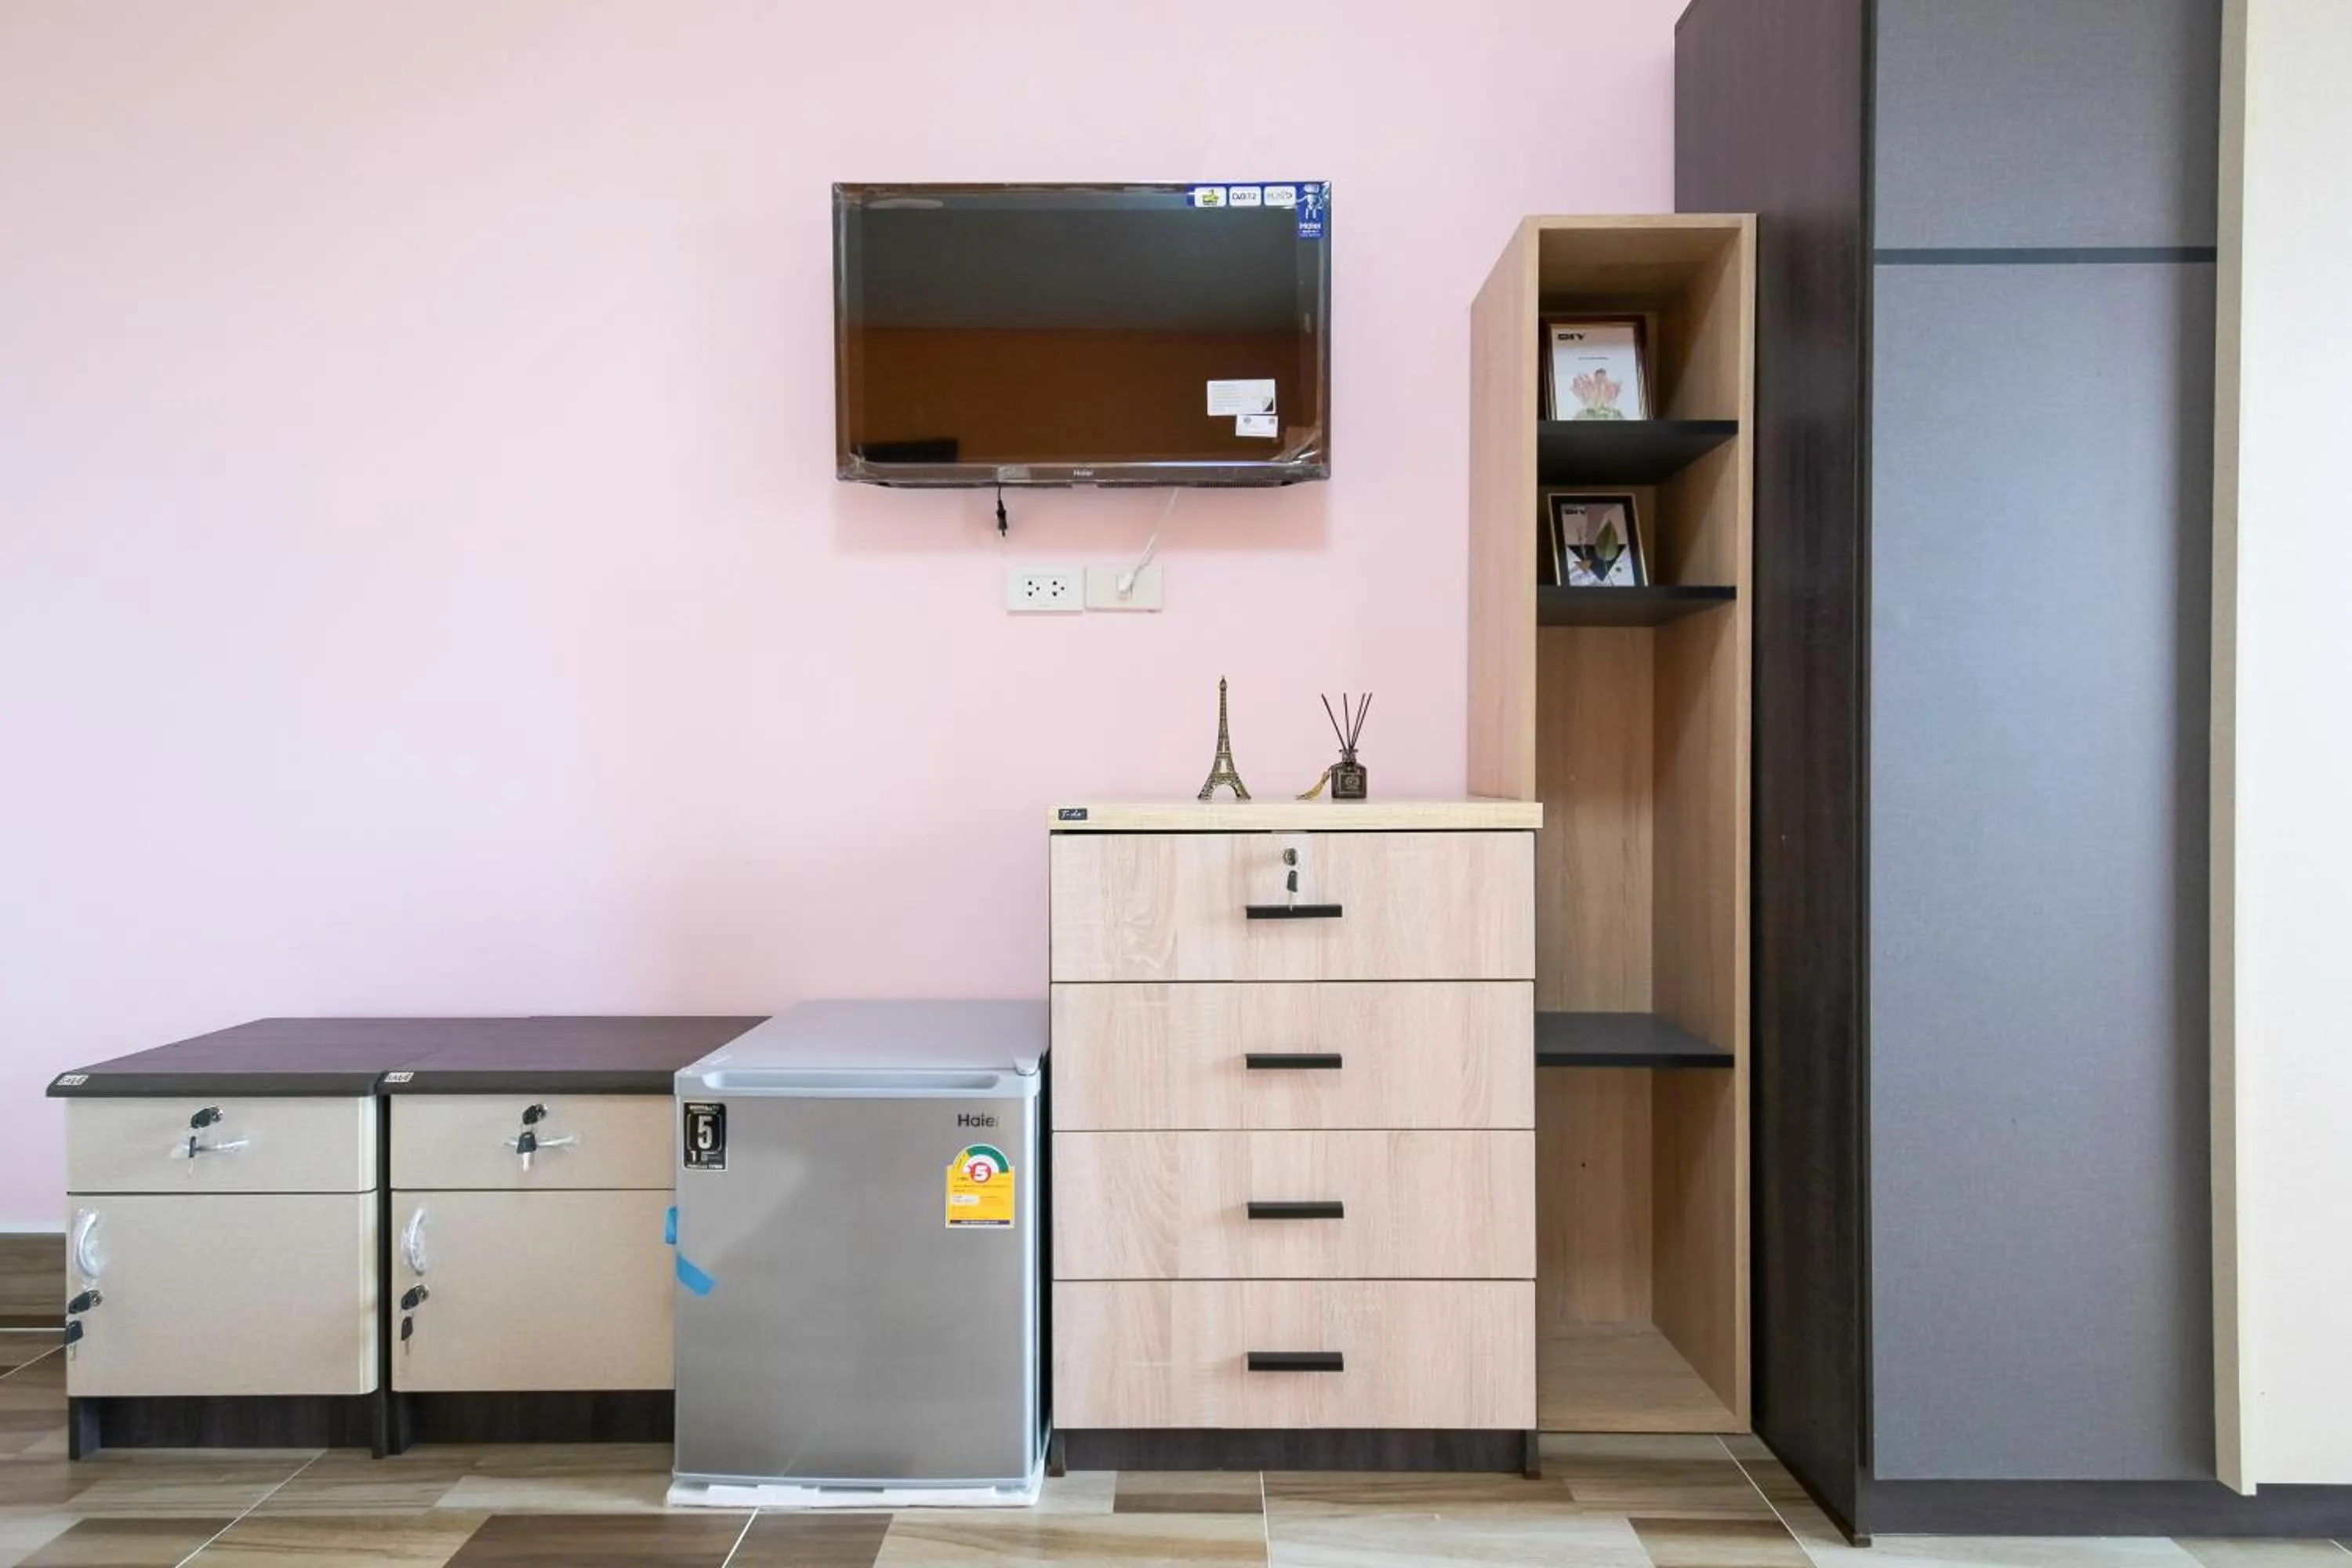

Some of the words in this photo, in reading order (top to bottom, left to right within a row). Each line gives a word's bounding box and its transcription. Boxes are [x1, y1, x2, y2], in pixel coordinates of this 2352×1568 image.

[698, 1116, 713, 1150] 5
[690, 1150, 696, 1162] 1
[974, 1164, 989, 1181] 5
